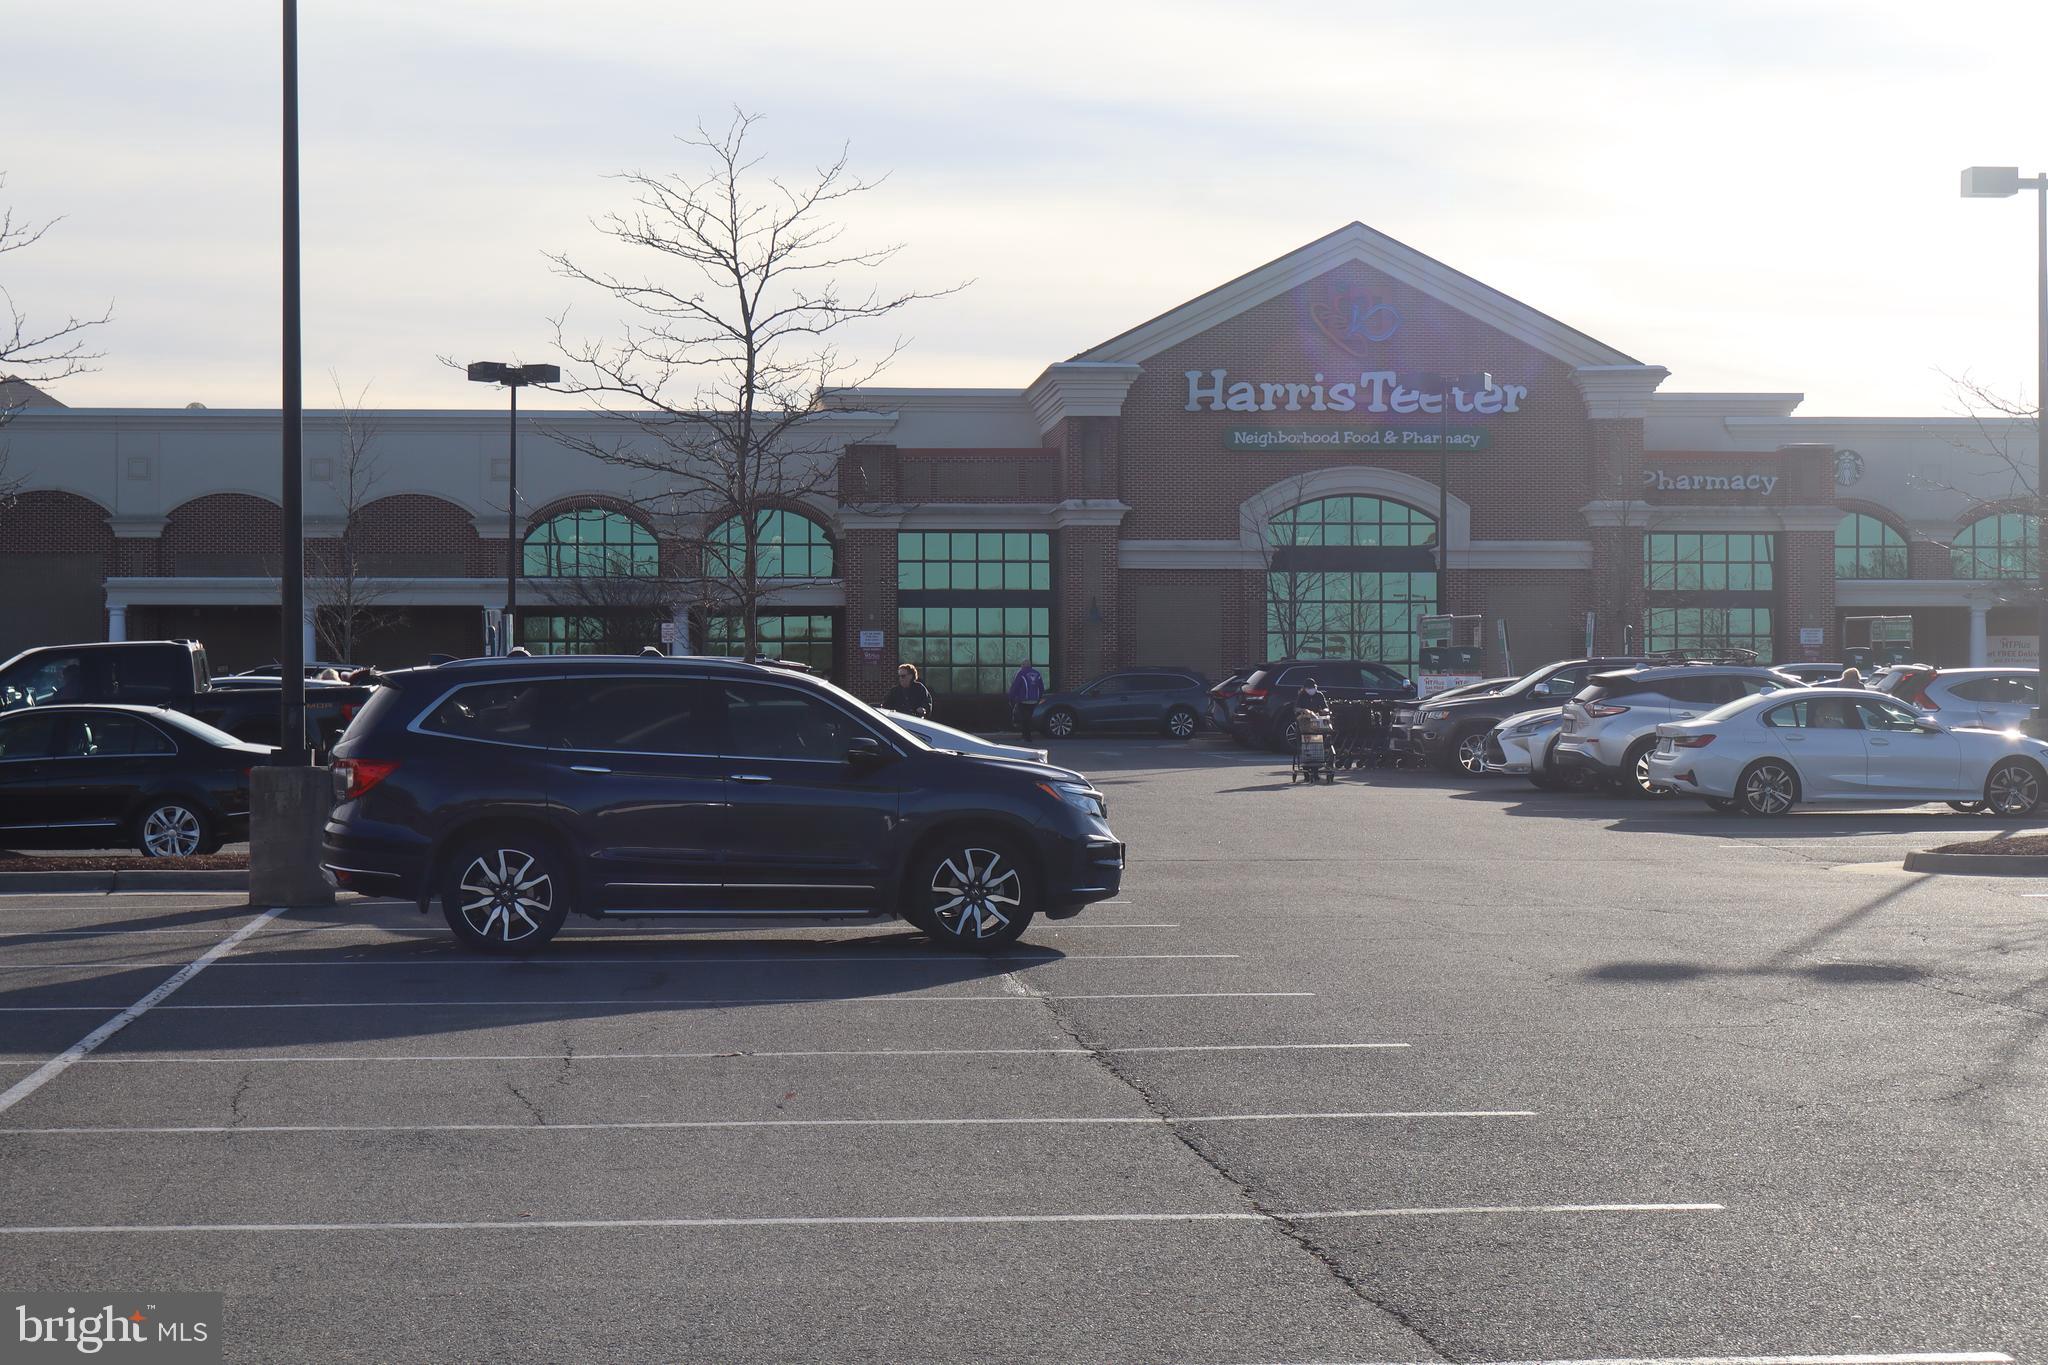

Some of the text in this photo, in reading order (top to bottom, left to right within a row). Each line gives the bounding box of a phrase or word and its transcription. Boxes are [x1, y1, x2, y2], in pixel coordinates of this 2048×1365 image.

[1184, 369, 1355, 412] Harris
[1234, 431, 1480, 448] Neighborhood Food & Pharmacy
